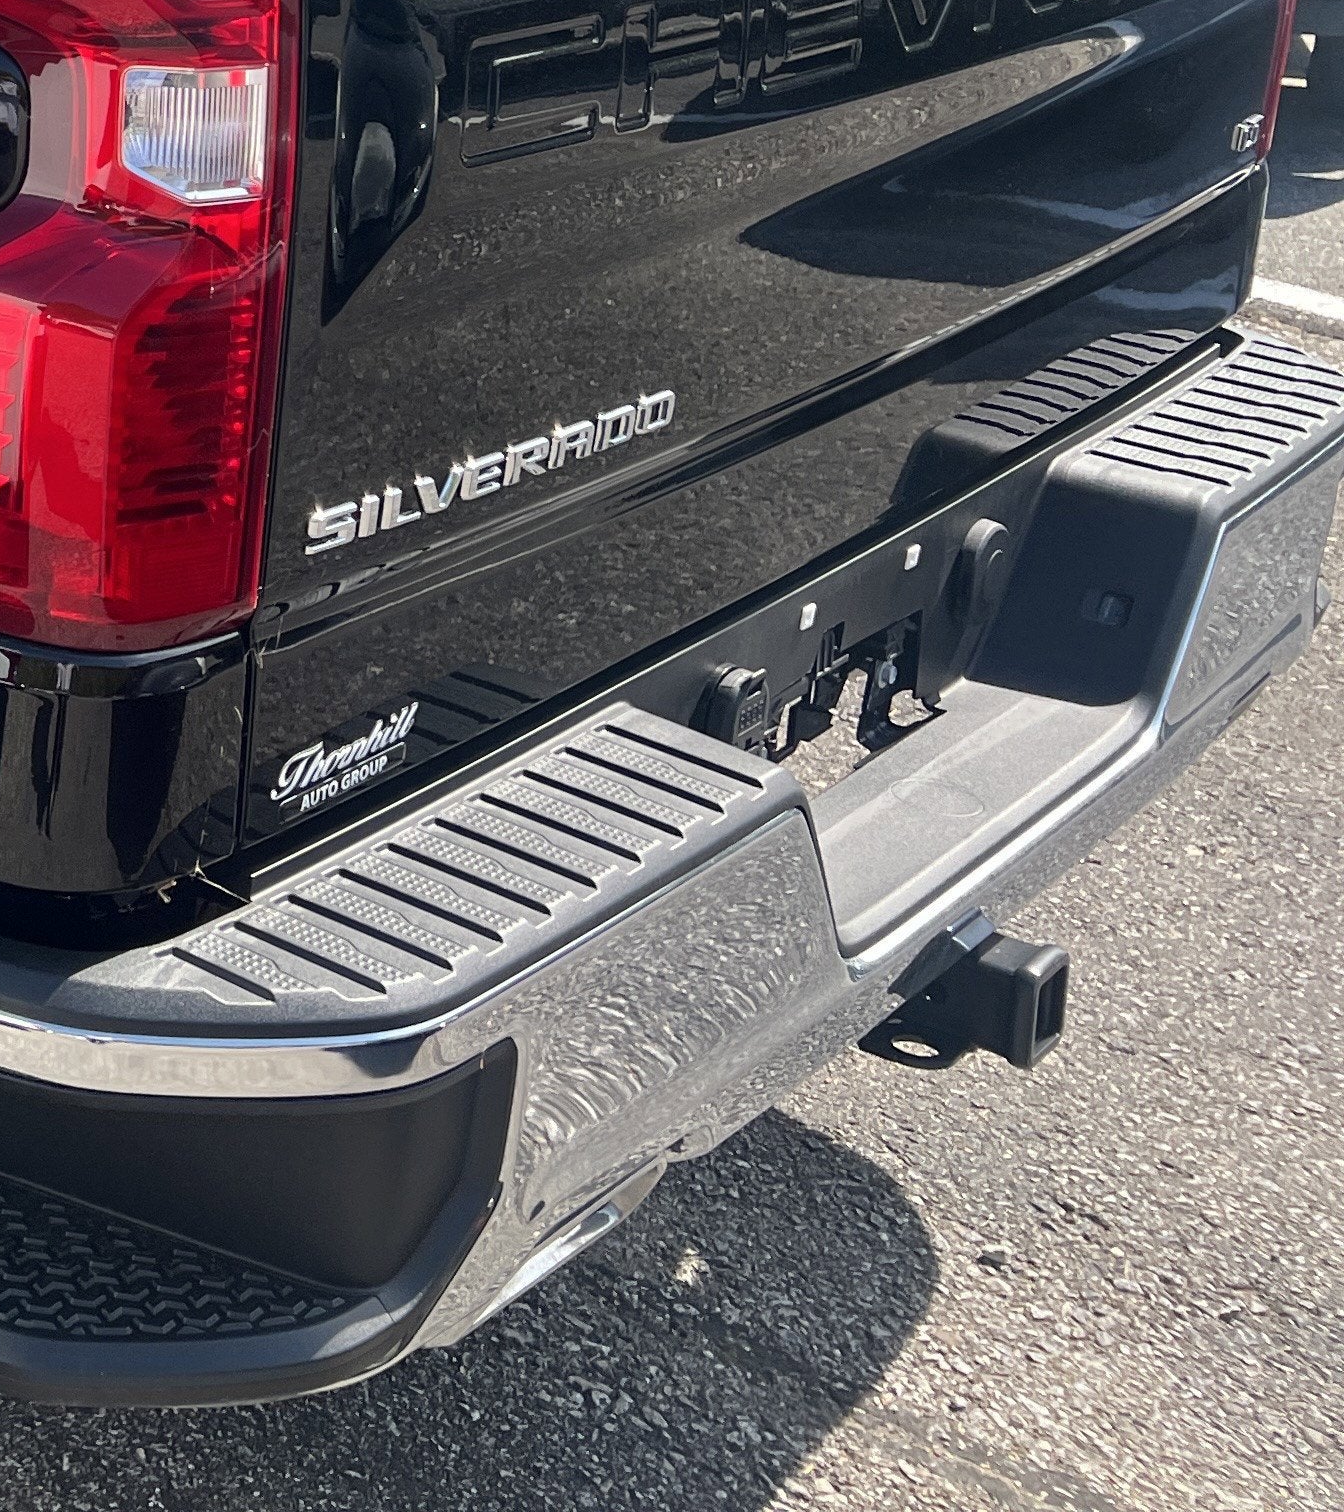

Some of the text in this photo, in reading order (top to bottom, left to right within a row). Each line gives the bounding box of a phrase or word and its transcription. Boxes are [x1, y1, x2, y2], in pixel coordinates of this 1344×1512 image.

[304, 389, 676, 556] SILVERADO
[269, 701, 419, 801] Thornhill
[299, 754, 388, 812] AUTO GROUP
